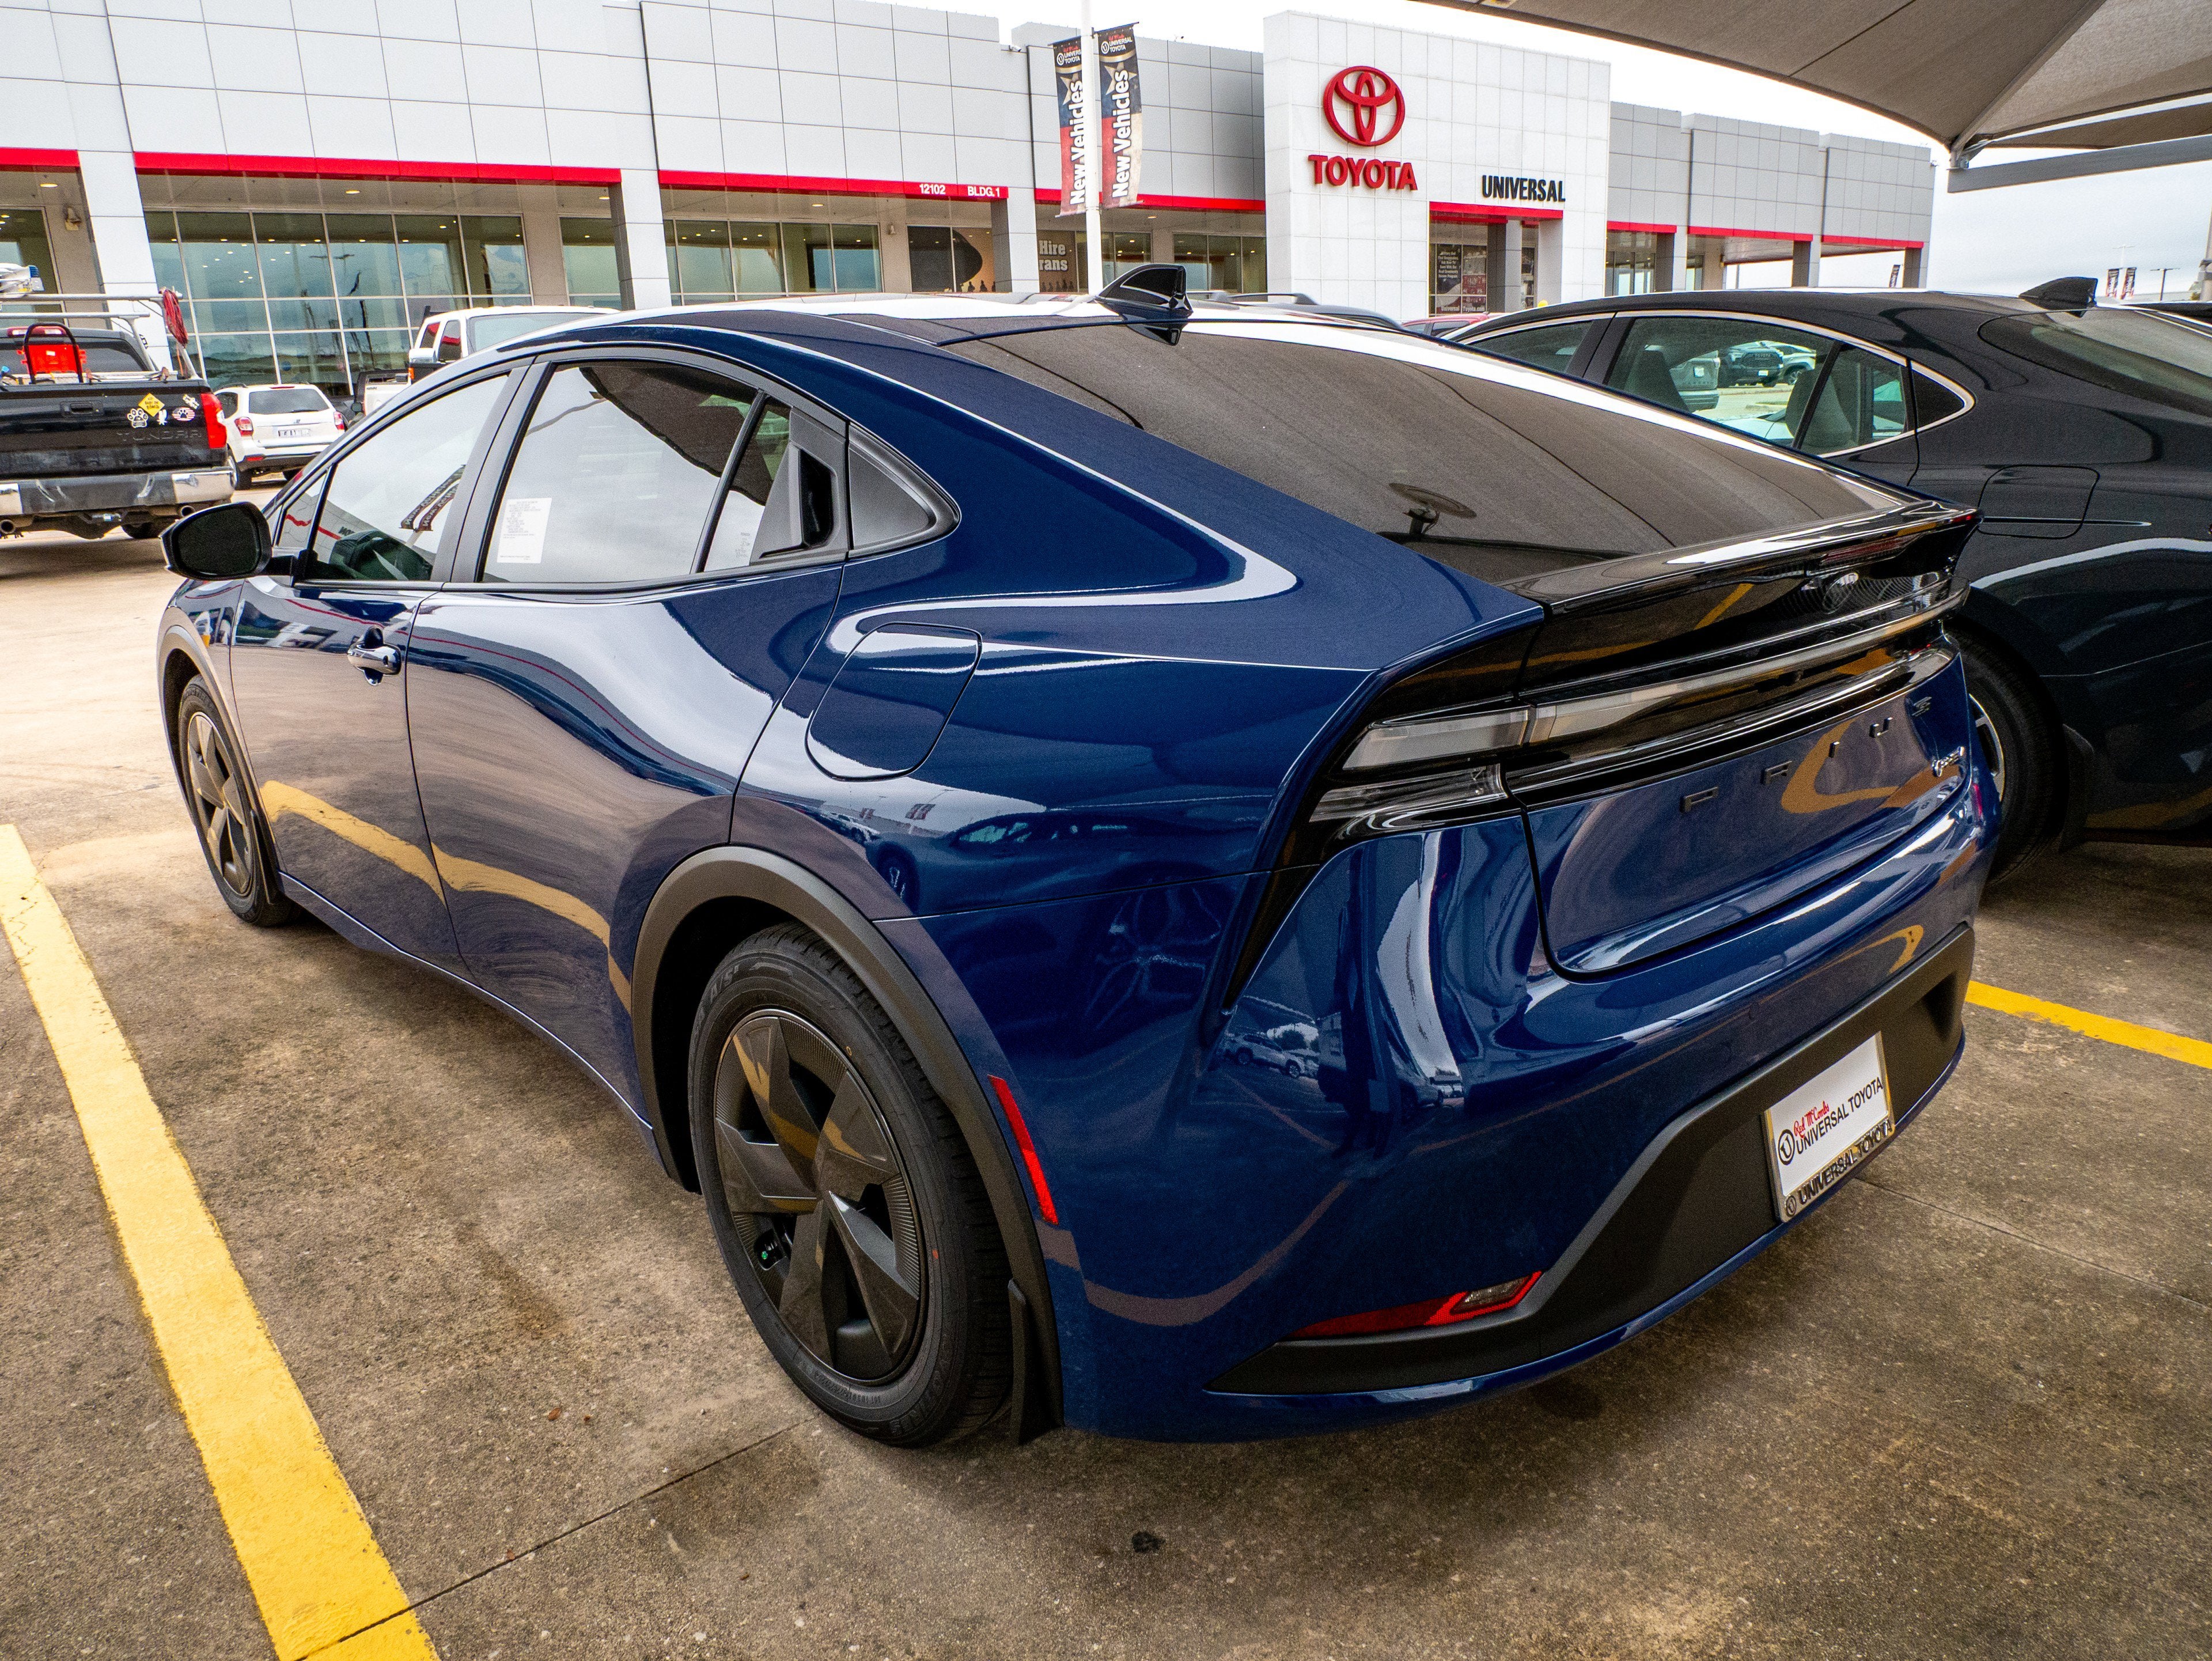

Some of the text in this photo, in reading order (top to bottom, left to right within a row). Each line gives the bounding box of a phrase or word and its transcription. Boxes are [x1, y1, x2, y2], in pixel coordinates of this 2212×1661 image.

[1109, 36, 1132, 47] UNIVERSAL
[1109, 44, 1126, 53] TOYOTA
[1064, 50, 1081, 58] UNIVERS
[1065, 56, 1081, 64] TOYOTA
[1069, 80, 1086, 205] New Vehicles
[1112, 70, 1131, 198] New Vehicles
[1308, 154, 1418, 191] TOYOTA
[919, 183, 1001, 197] 12102 BLDG. 1
[1482, 175, 1566, 202] UNIVERSAL
[1039, 240, 1066, 255] Hire
[1680, 697, 1933, 814] PRIUS
[1793, 1117, 1806, 1138] Red
[1796, 1103, 1849, 1155] UNIVERSAL
[1848, 1077, 1884, 1113] TOYOTA
[1798, 1148, 1858, 1205] UNIVERSAL
[1857, 1118, 1892, 1156] TOYOTA
